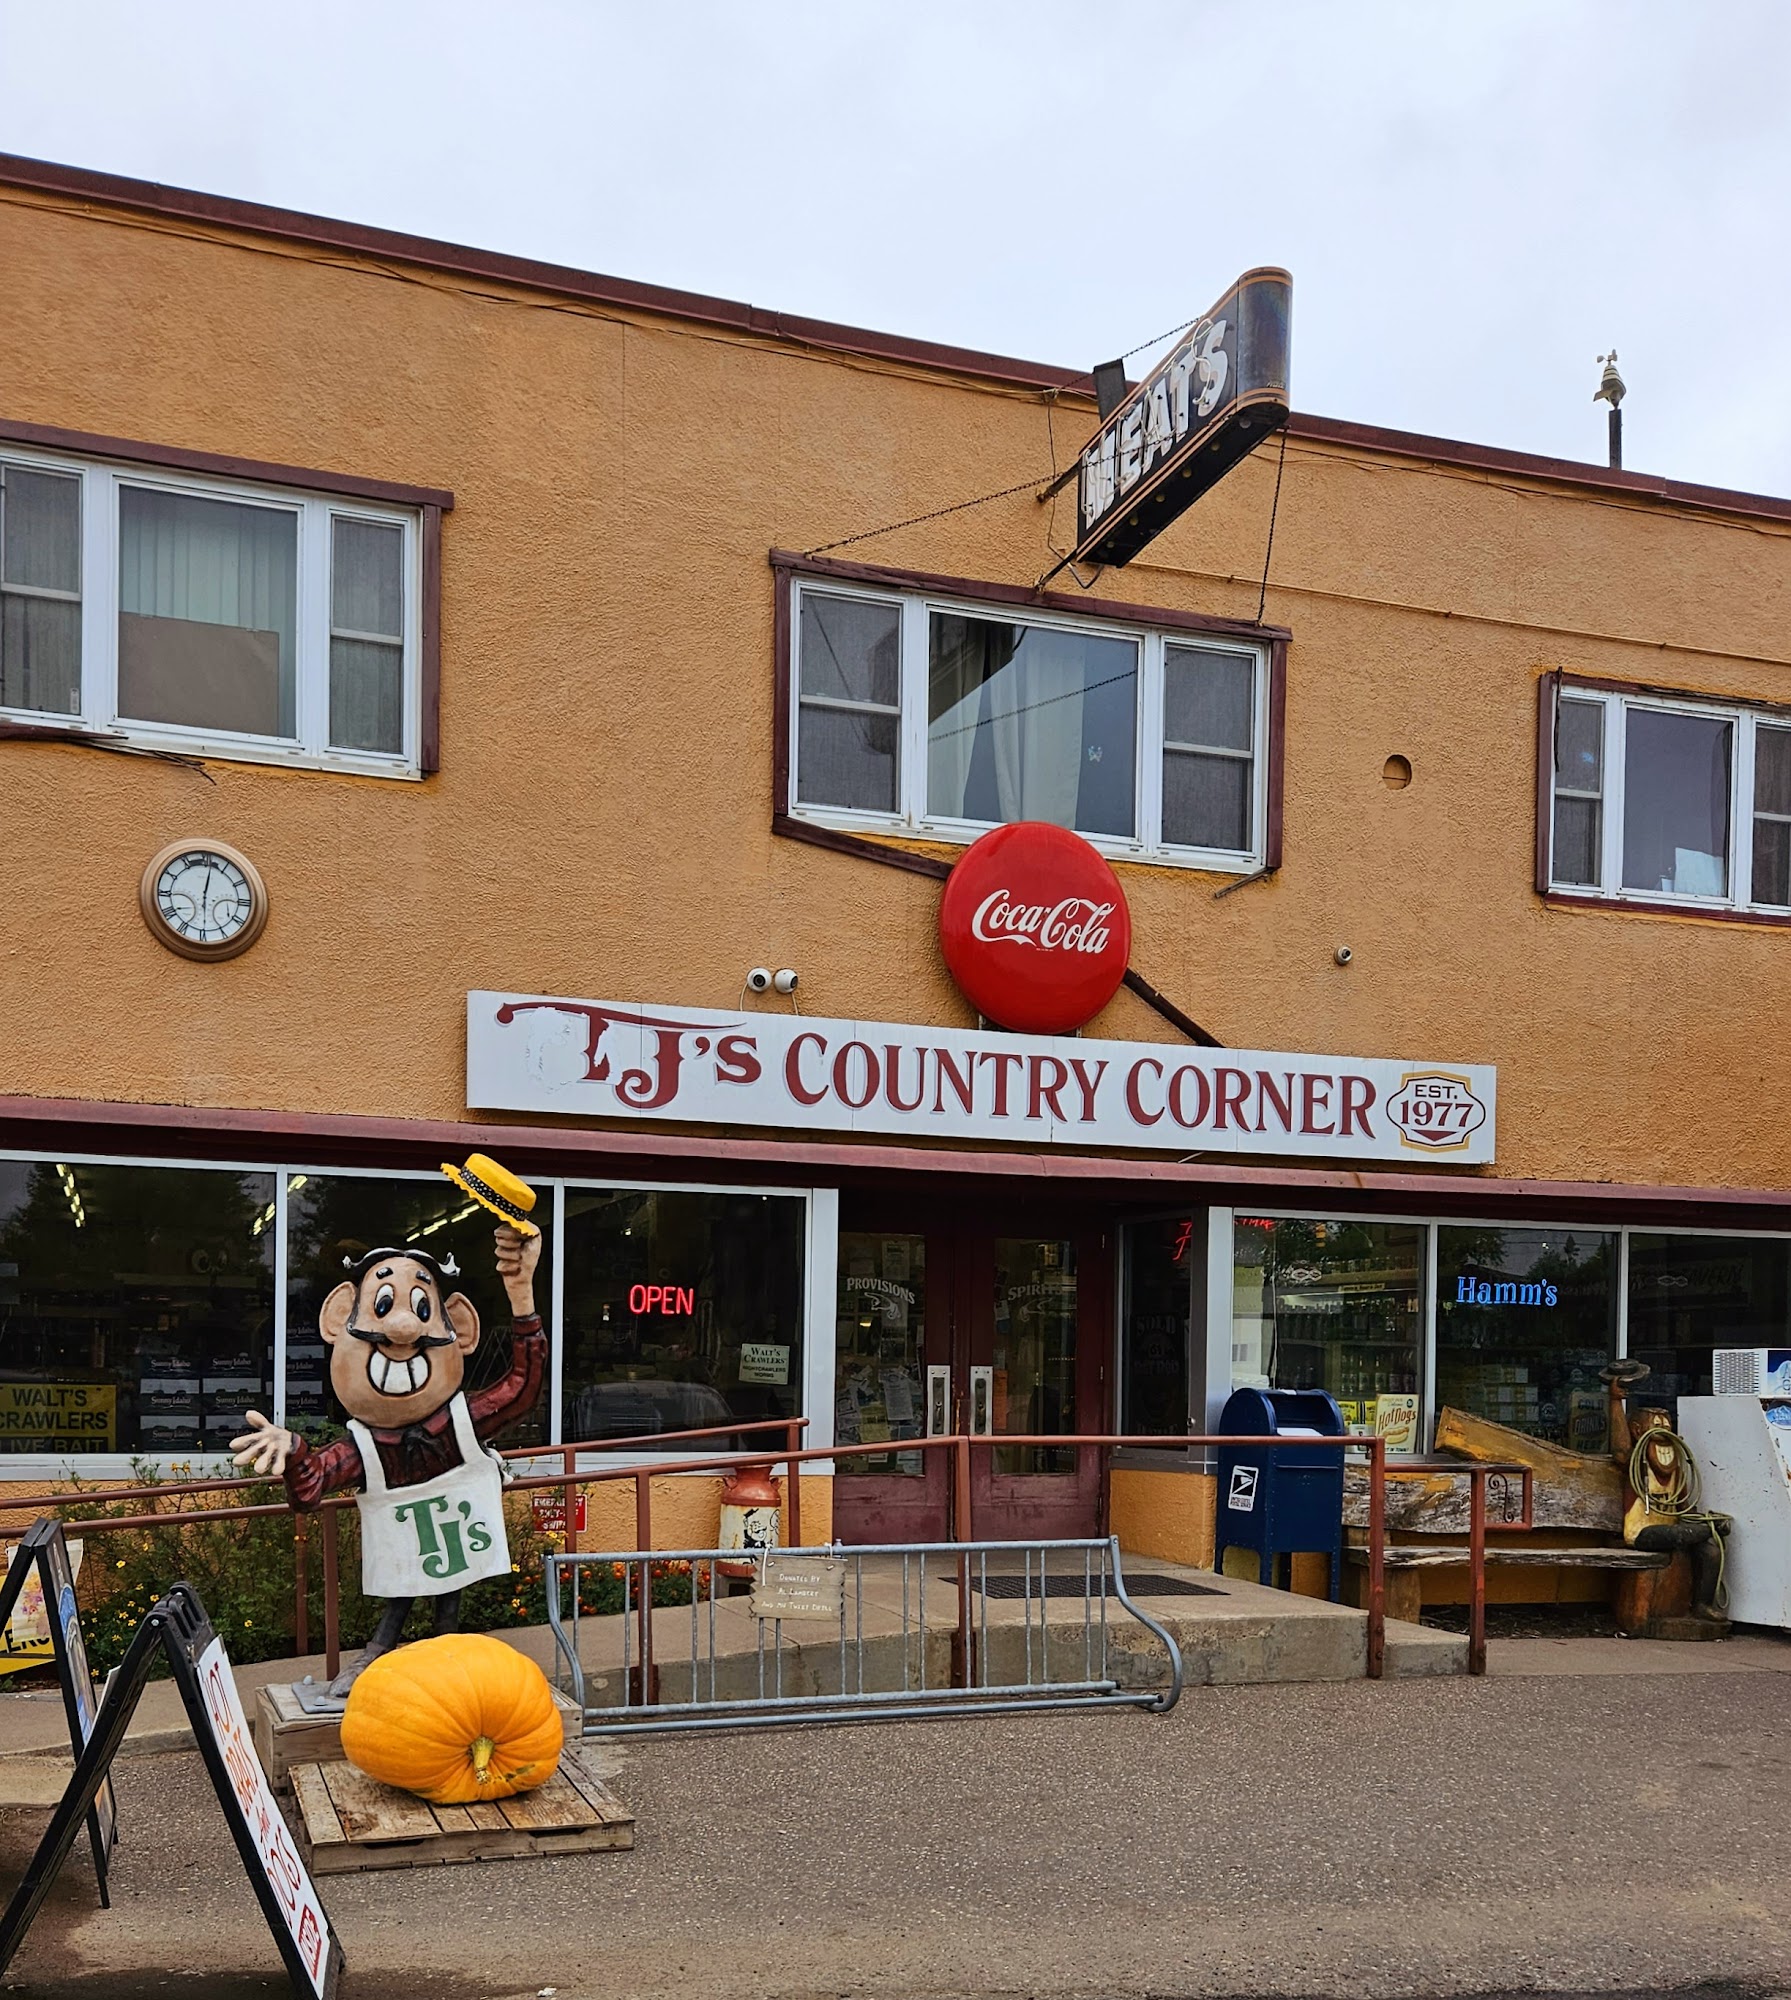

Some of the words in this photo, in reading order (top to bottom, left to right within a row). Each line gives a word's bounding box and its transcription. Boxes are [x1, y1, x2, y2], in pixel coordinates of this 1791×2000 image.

[1081, 318, 1229, 531] MEATS
[972, 889, 1117, 954] Coca-Cola
[786, 1032, 1109, 1123] COUNTRY
[1125, 1057, 1377, 1141] CORNER
[1414, 1084, 1458, 1099] EST.
[1400, 1100, 1475, 1127] 1977
[629, 1284, 694, 1315] OPEN
[846, 1277, 916, 1305] PROVISIONS
[1456, 1276, 1558, 1307] Hamm's
[12, 1388, 88, 1407] WALT'S
[0, 1439, 45, 1453] IVE
[394, 1495, 493, 1579] TJ's
